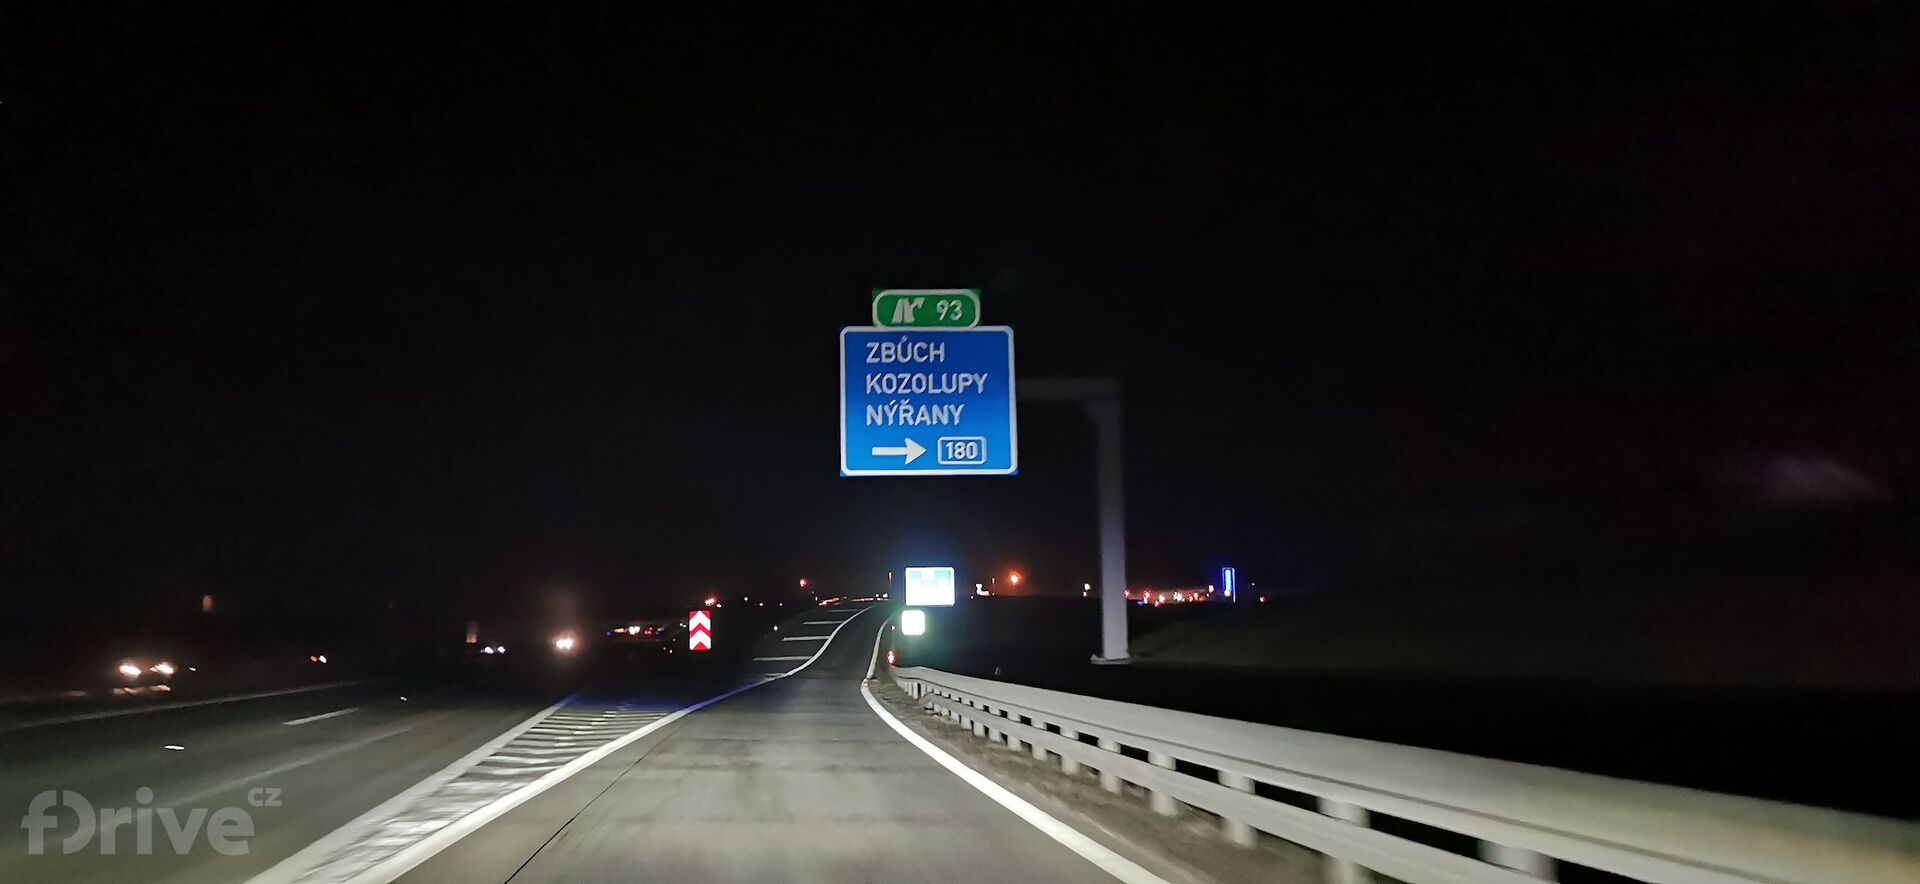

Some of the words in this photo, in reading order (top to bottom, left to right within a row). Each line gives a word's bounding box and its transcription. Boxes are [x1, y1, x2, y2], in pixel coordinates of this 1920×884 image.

[936, 299, 963, 321] 93
[866, 373, 988, 394] KOZOLUPY
[866, 399, 965, 426] NÝŘANY
[945, 441, 978, 460] 180
